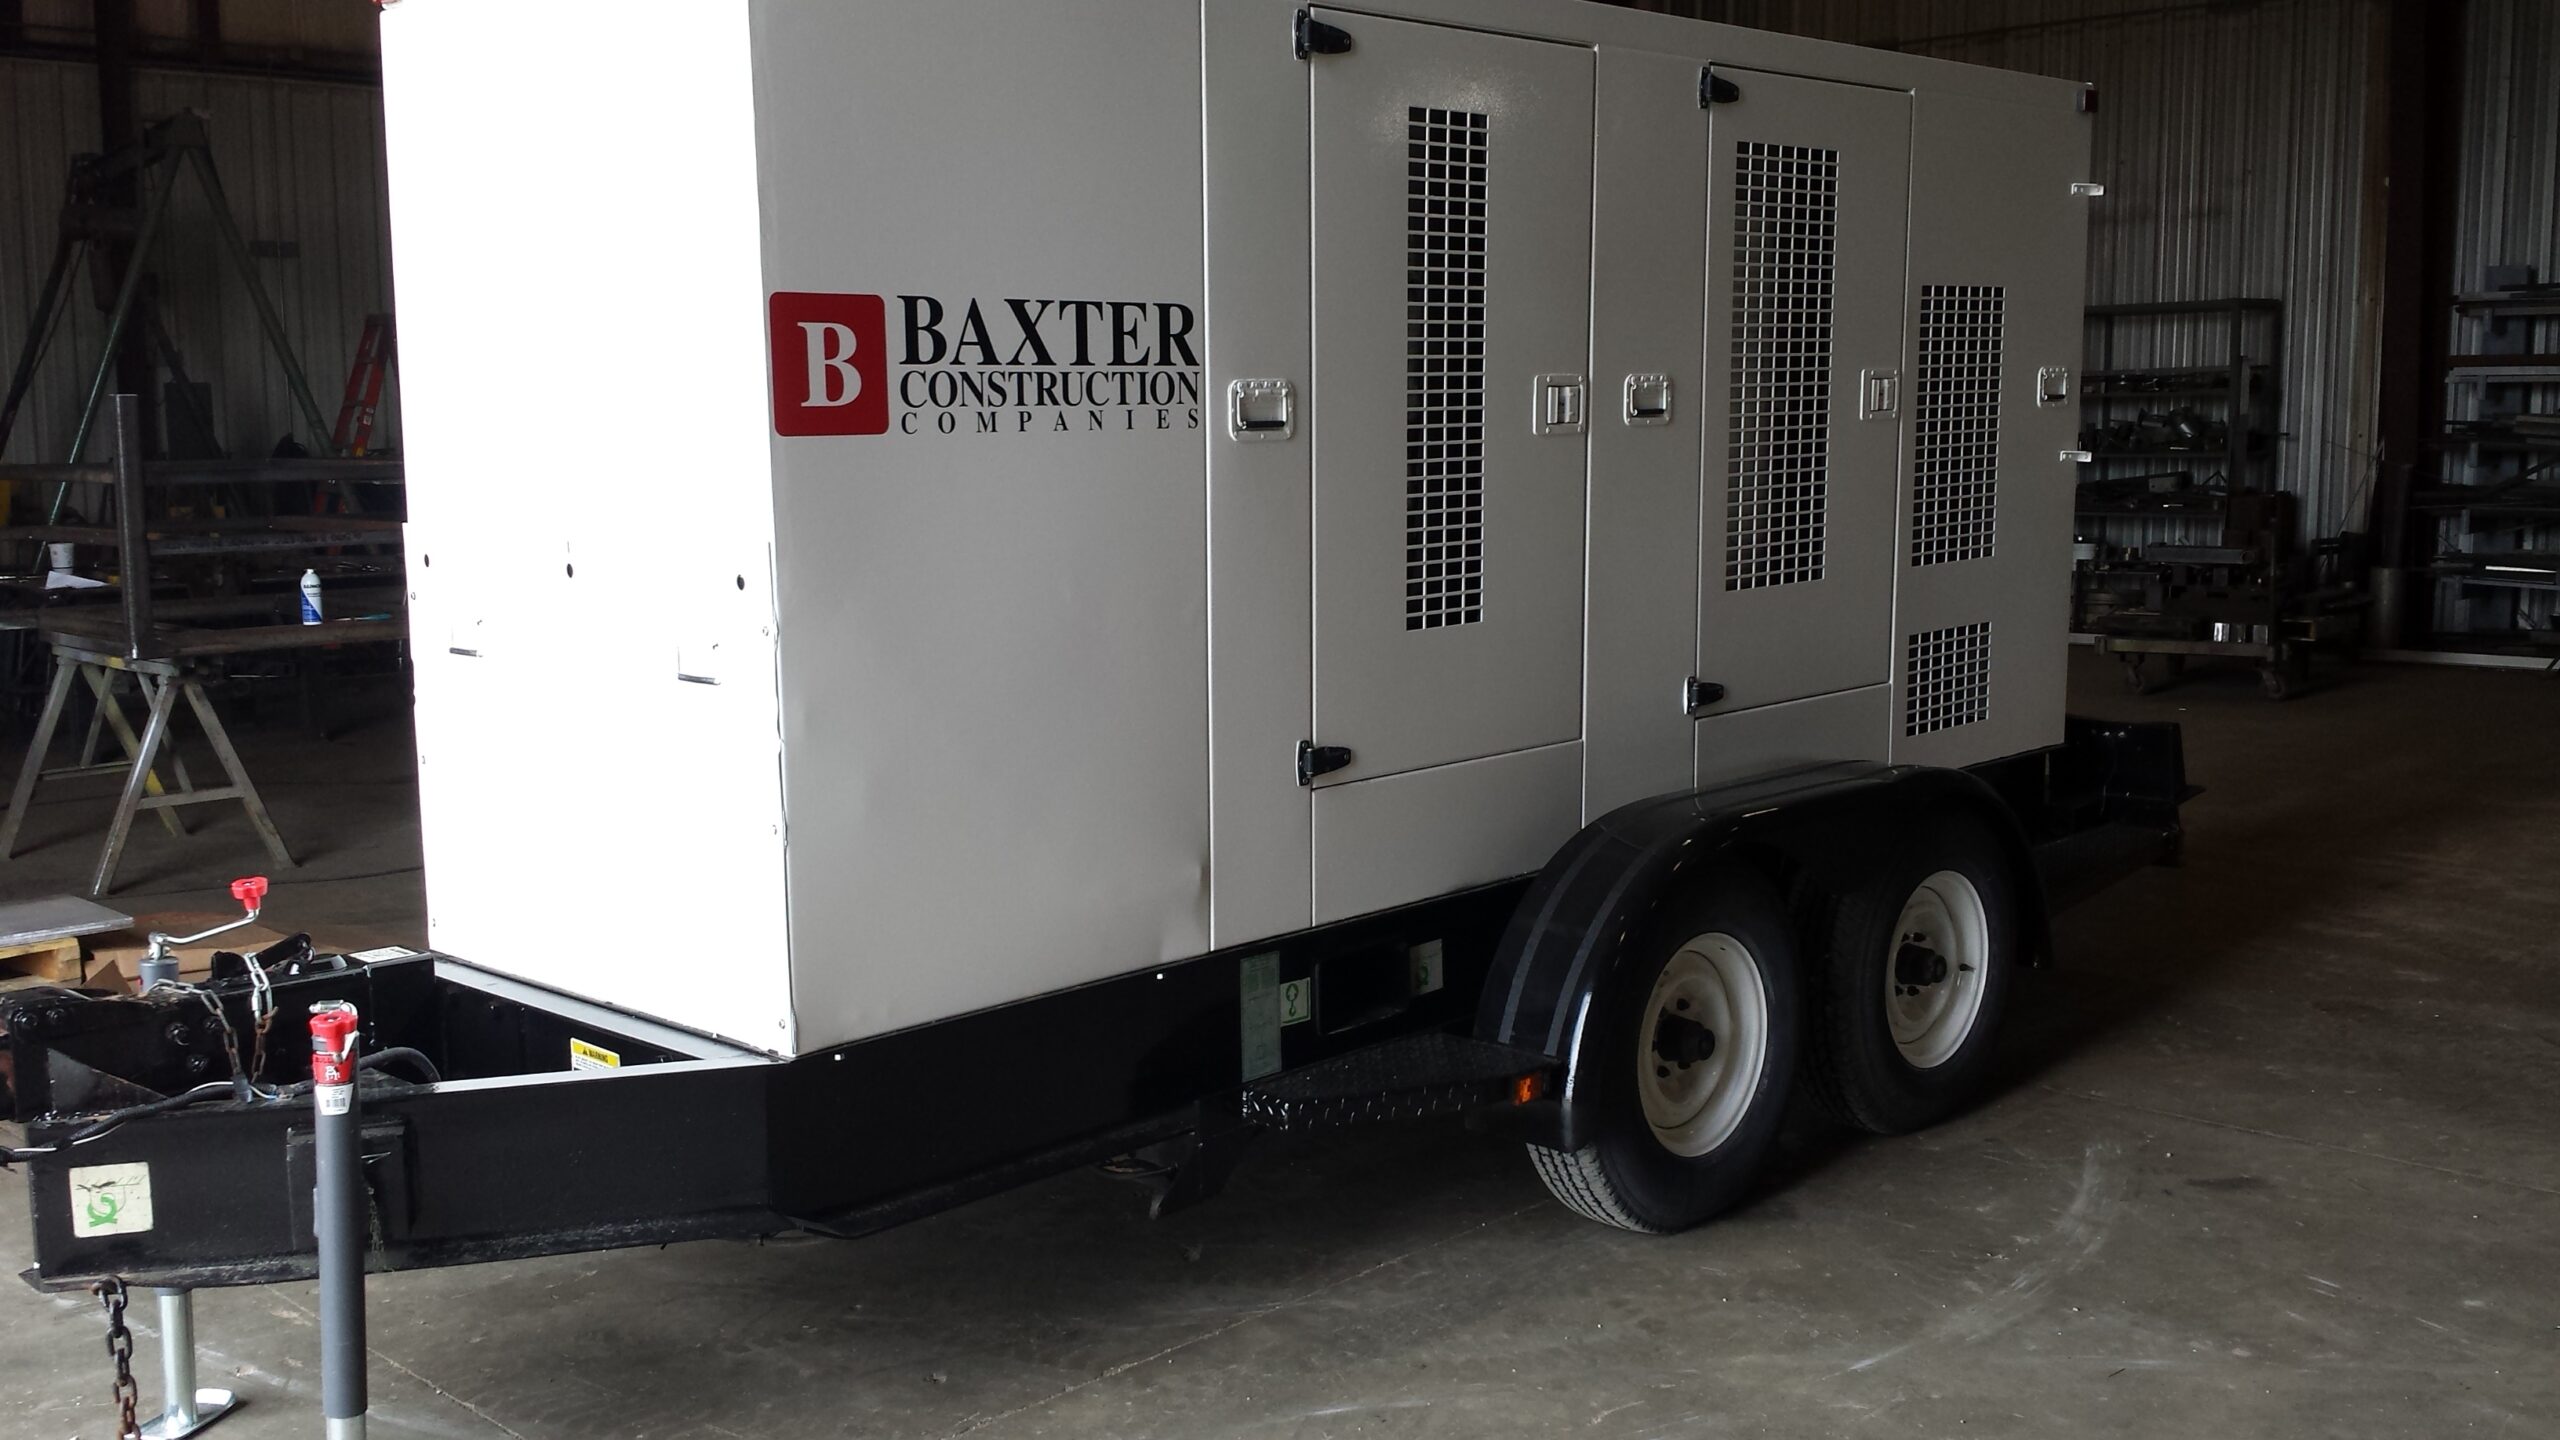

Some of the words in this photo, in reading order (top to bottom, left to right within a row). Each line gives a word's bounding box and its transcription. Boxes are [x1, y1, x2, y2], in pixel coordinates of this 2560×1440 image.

[896, 295, 1200, 367] BAXTER
[797, 321, 862, 407] B
[900, 370, 1200, 408] CONSTRUCTION
[900, 408, 1199, 435] COMPANIES
